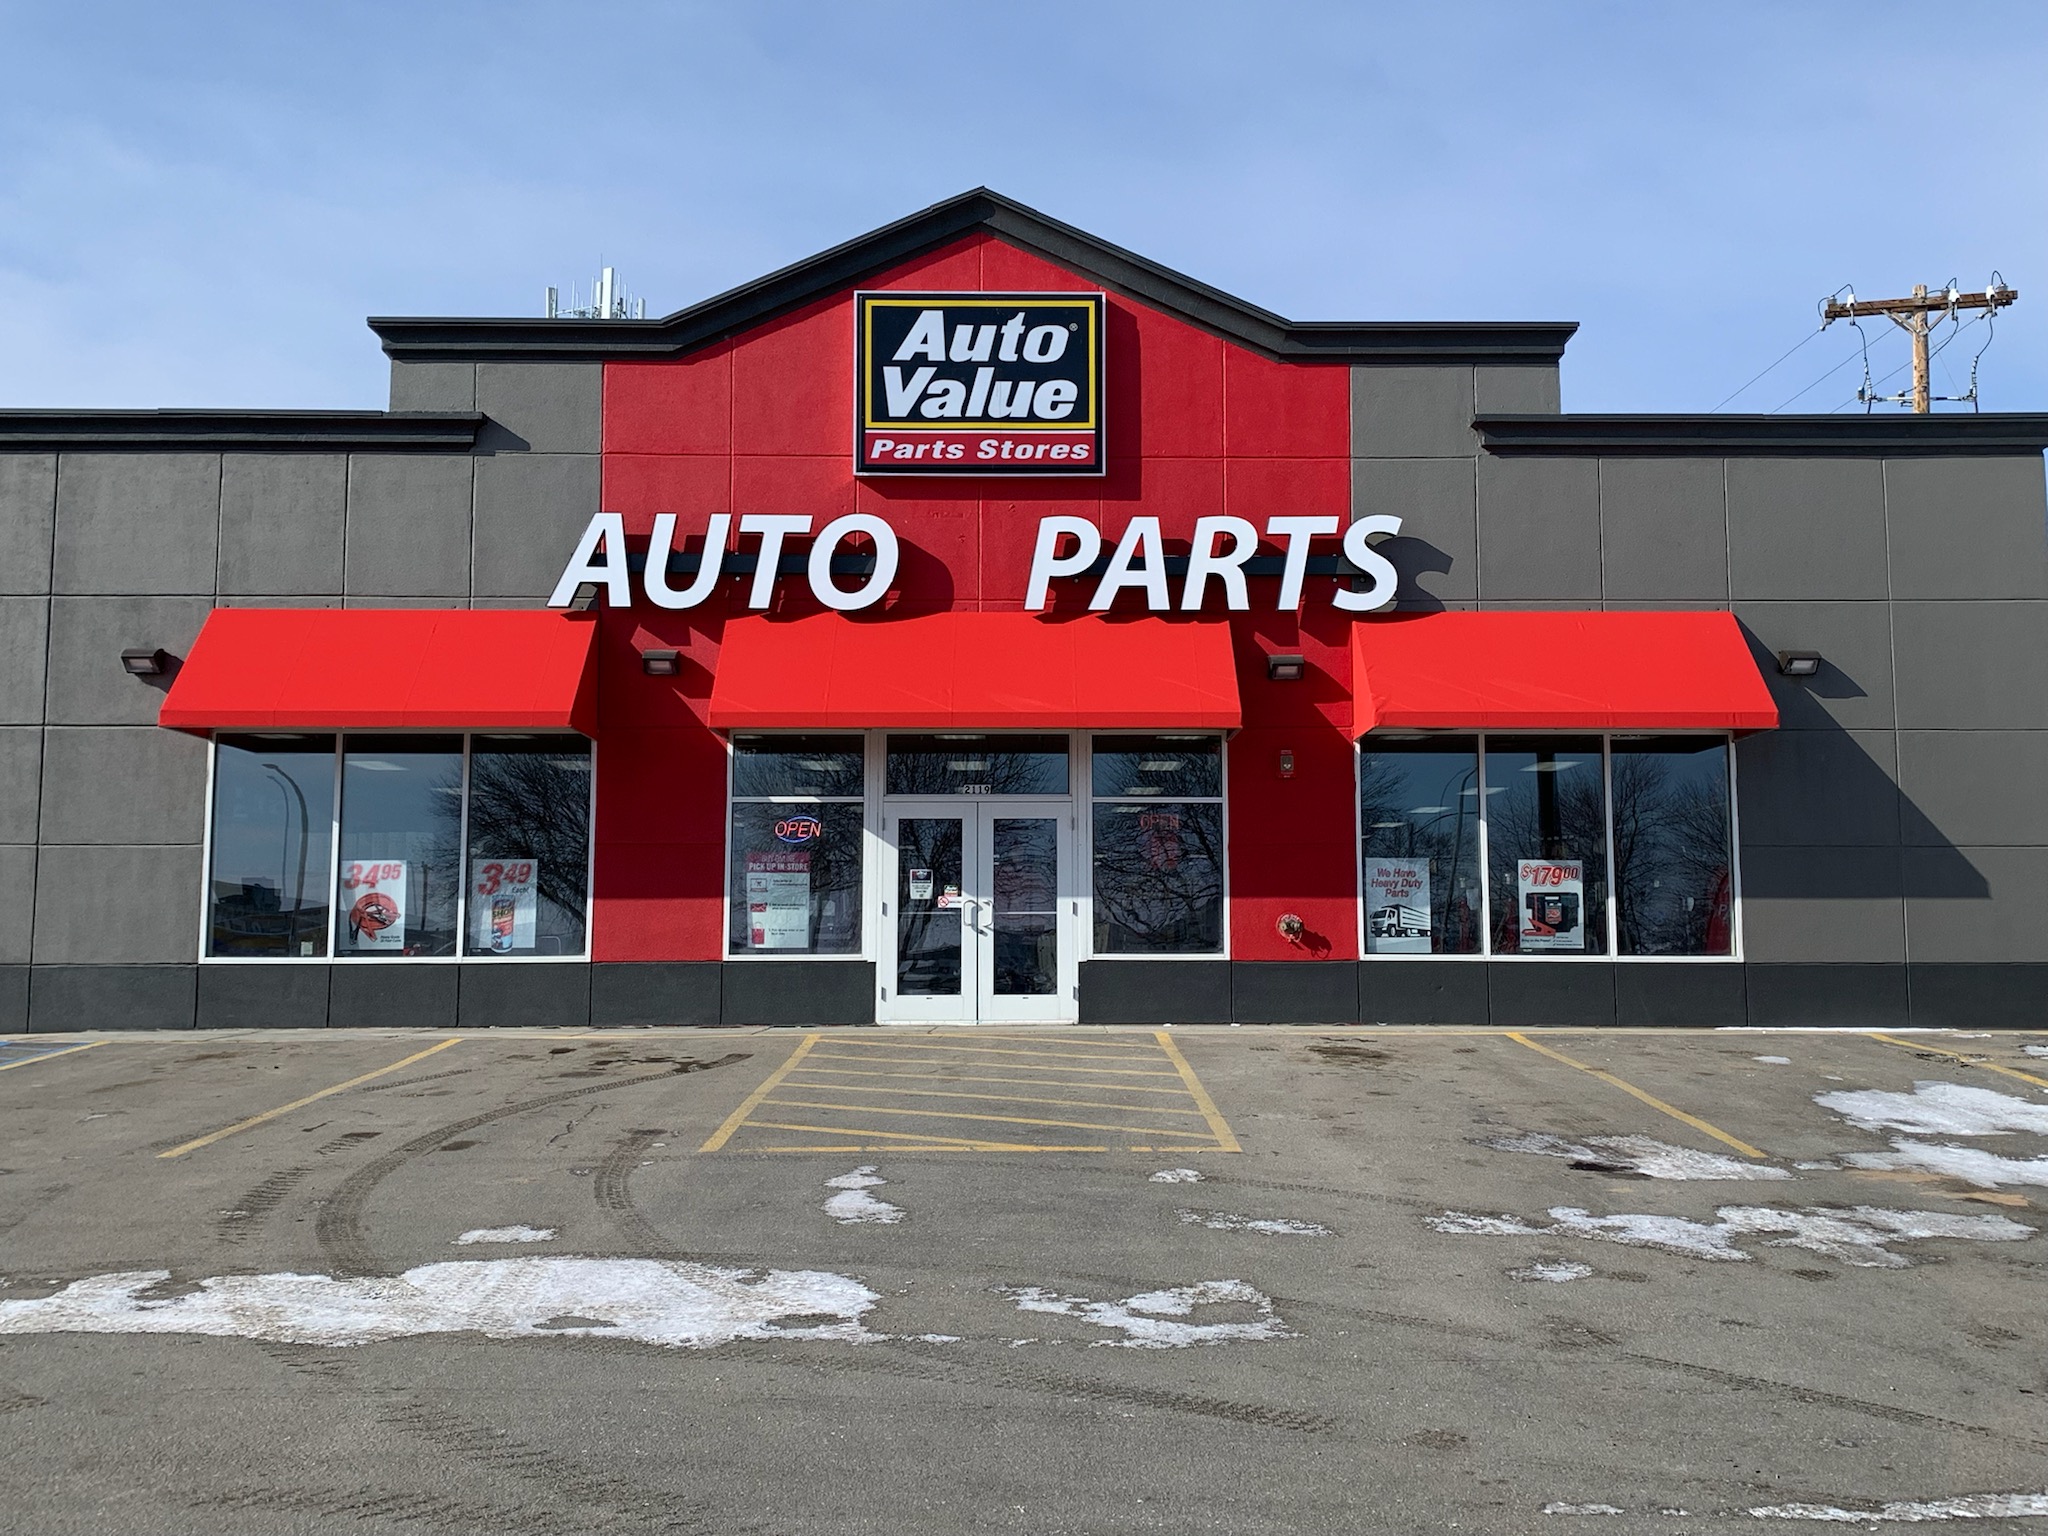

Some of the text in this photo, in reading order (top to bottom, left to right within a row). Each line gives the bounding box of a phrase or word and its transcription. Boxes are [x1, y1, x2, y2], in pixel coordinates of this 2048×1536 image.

[892, 309, 1069, 363] Auto
[882, 365, 1078, 420] Value
[870, 439, 1090, 460] Parts Stores
[546, 512, 1403, 612] AUTO PARTS
[964, 785, 990, 794] 2119
[775, 821, 821, 837] OPEN
[748, 863, 765, 871] PICK
[767, 863, 776, 871] UP
[1377, 868, 1417, 878] We Have
[1371, 878, 1423, 889] Heavy Duty
[1385, 888, 1409, 898] Parts
